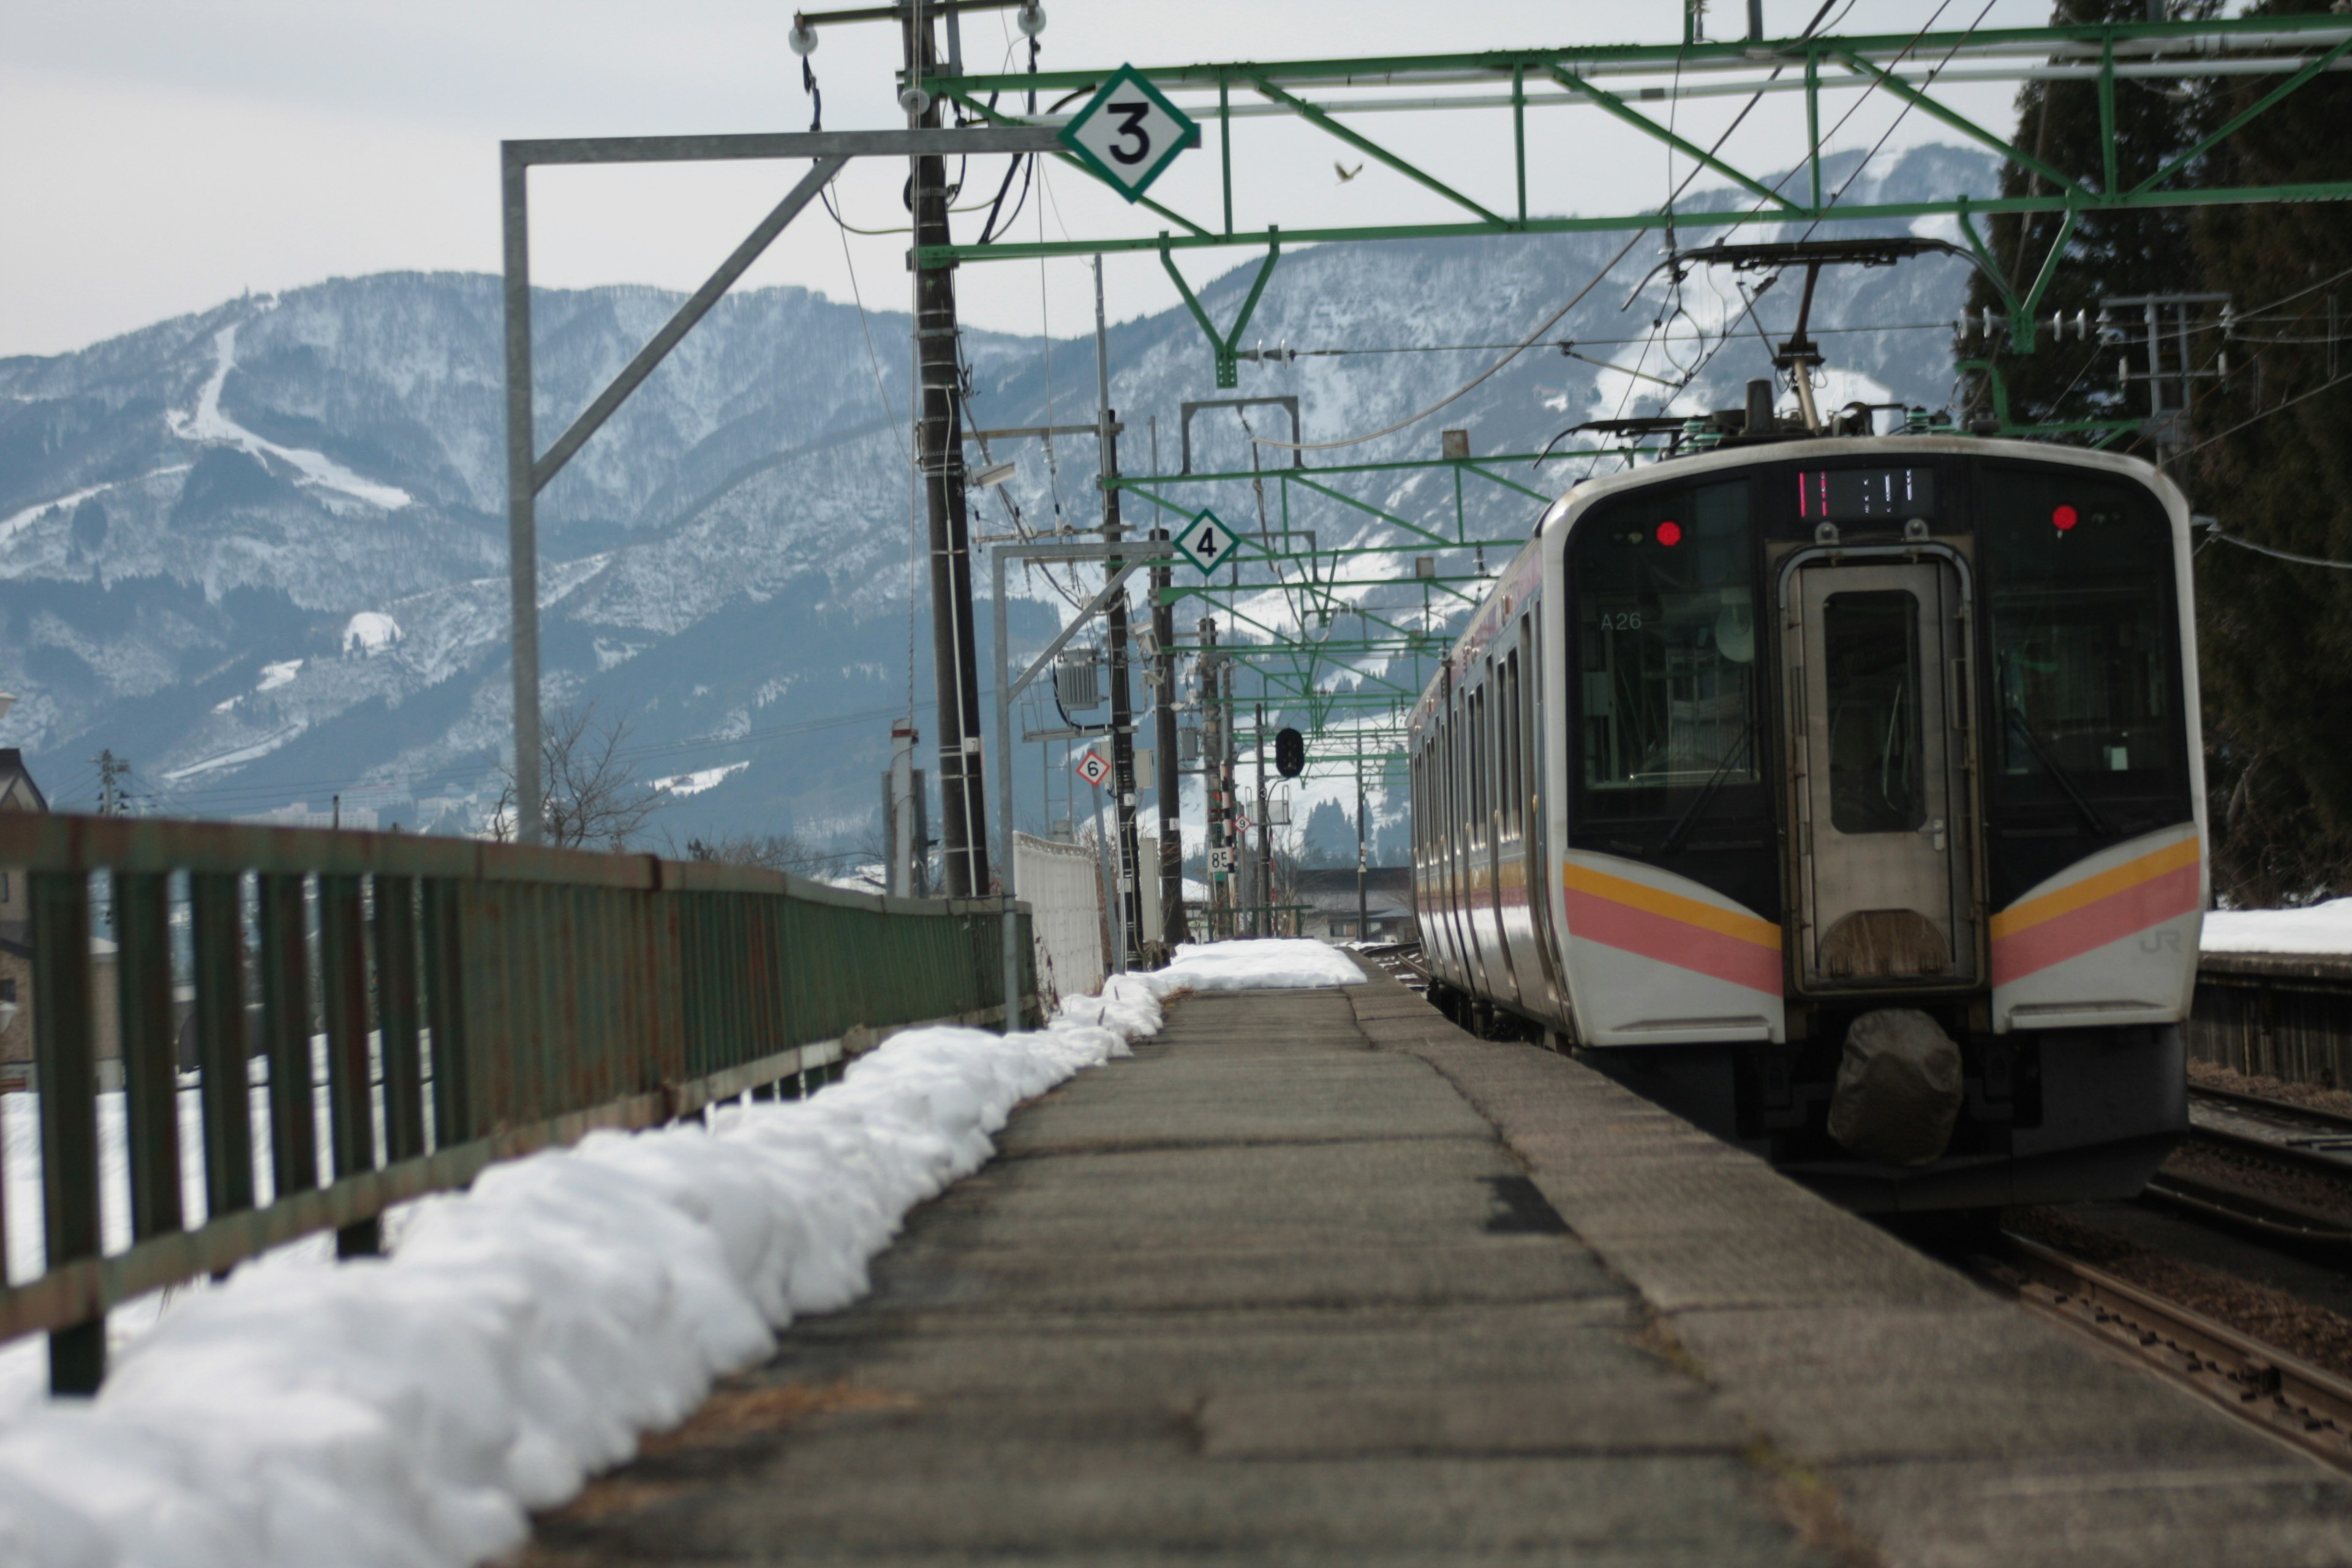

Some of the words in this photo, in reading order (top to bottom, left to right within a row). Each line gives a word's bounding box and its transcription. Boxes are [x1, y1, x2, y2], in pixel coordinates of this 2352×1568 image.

[1107, 102, 1150, 165] 3
[1197, 527, 1217, 557] 4
[1600, 612, 1642, 631] A26
[1087, 761, 1099, 777] 6
[1239, 819, 1245, 828] 9
[1212, 851, 1229, 868] 85
[2139, 929, 2185, 954] JR
